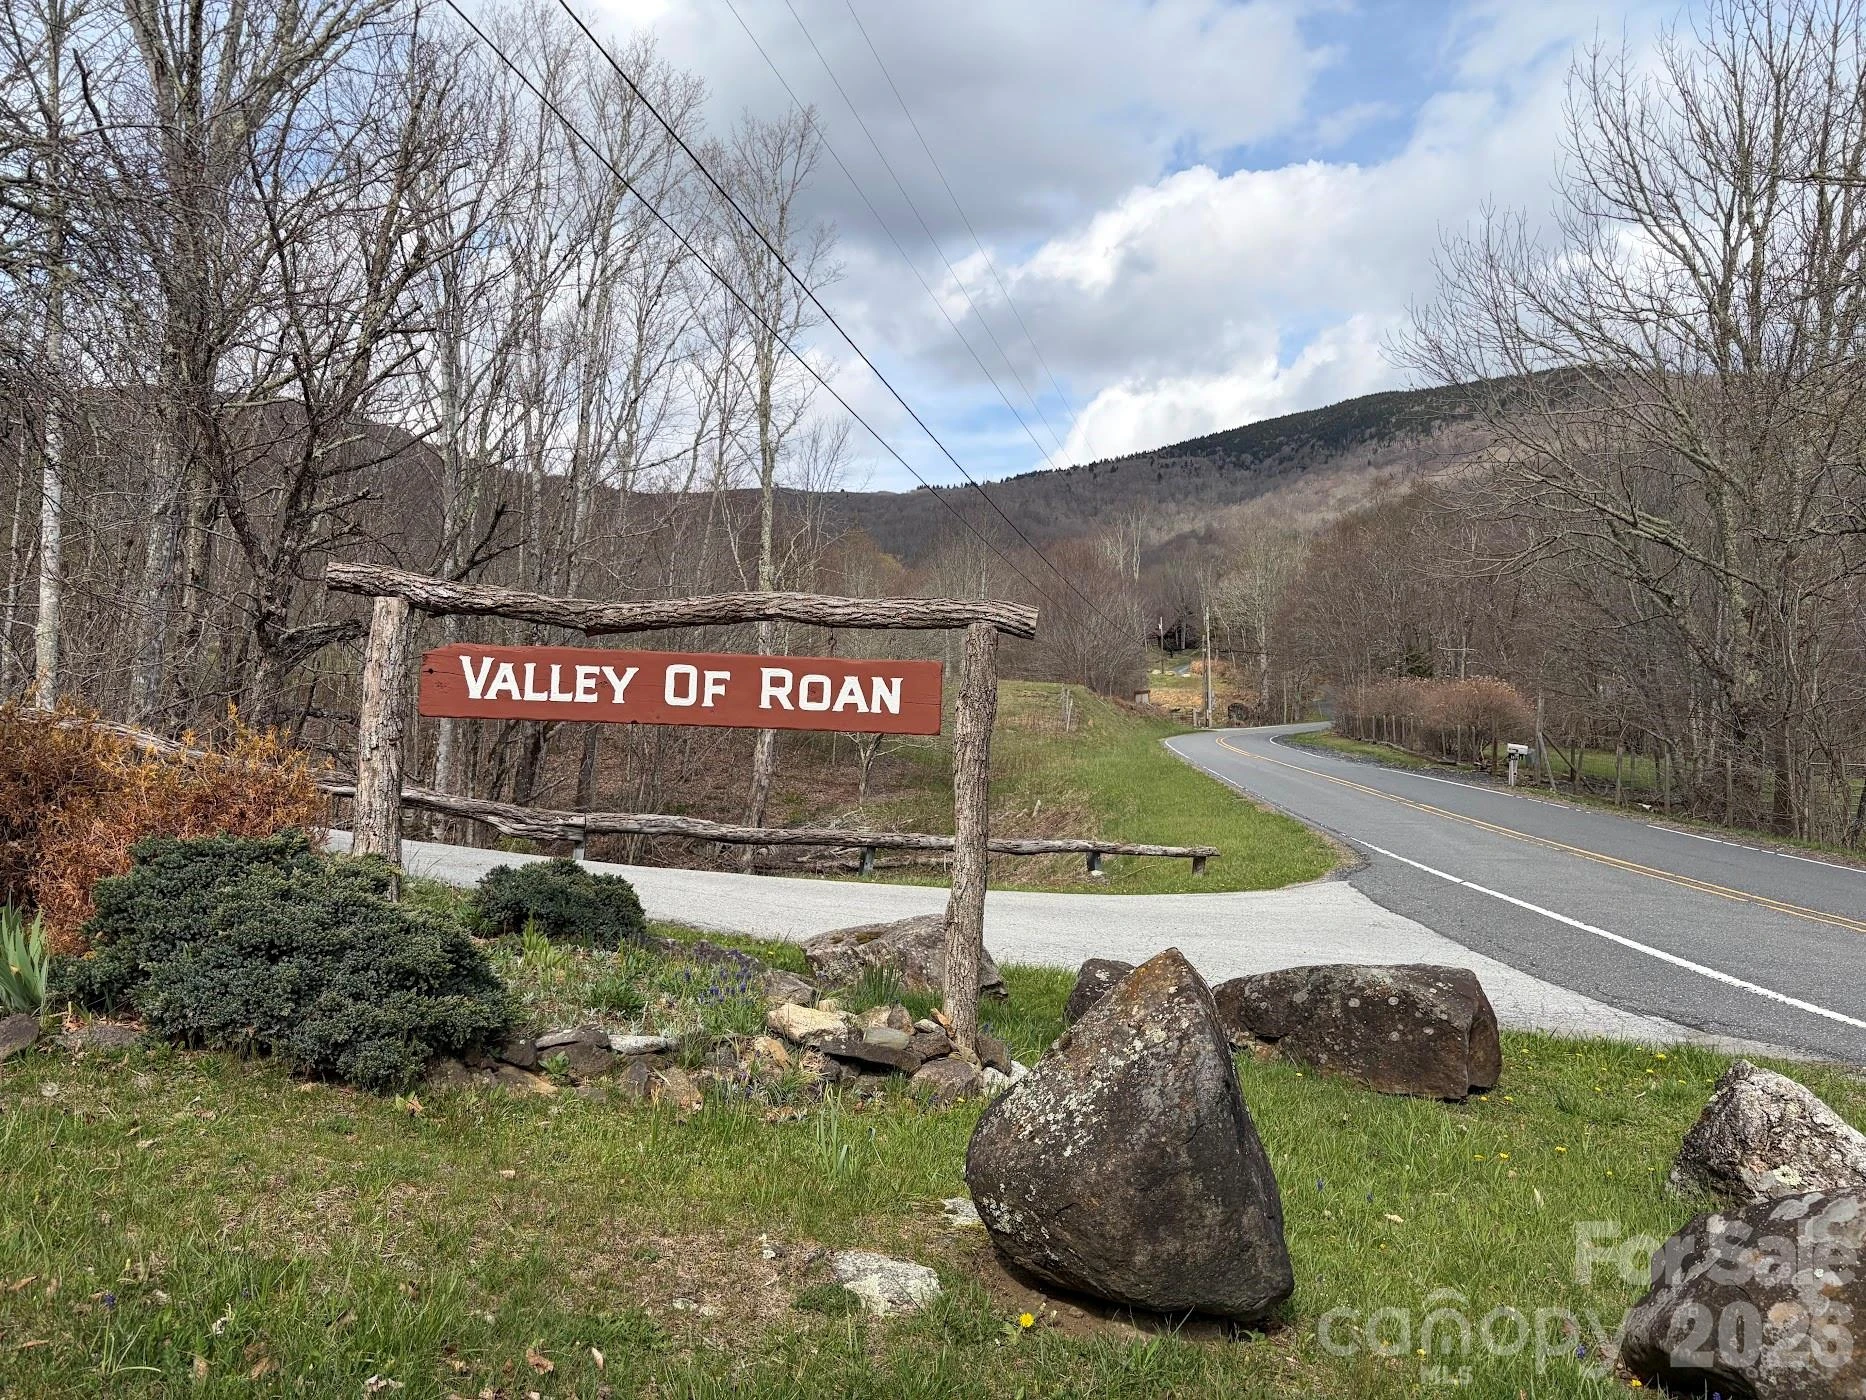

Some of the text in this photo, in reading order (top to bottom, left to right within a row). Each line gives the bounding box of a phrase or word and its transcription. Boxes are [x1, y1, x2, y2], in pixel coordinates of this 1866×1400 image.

[459, 655, 904, 715] VALLEY OF ROAN
